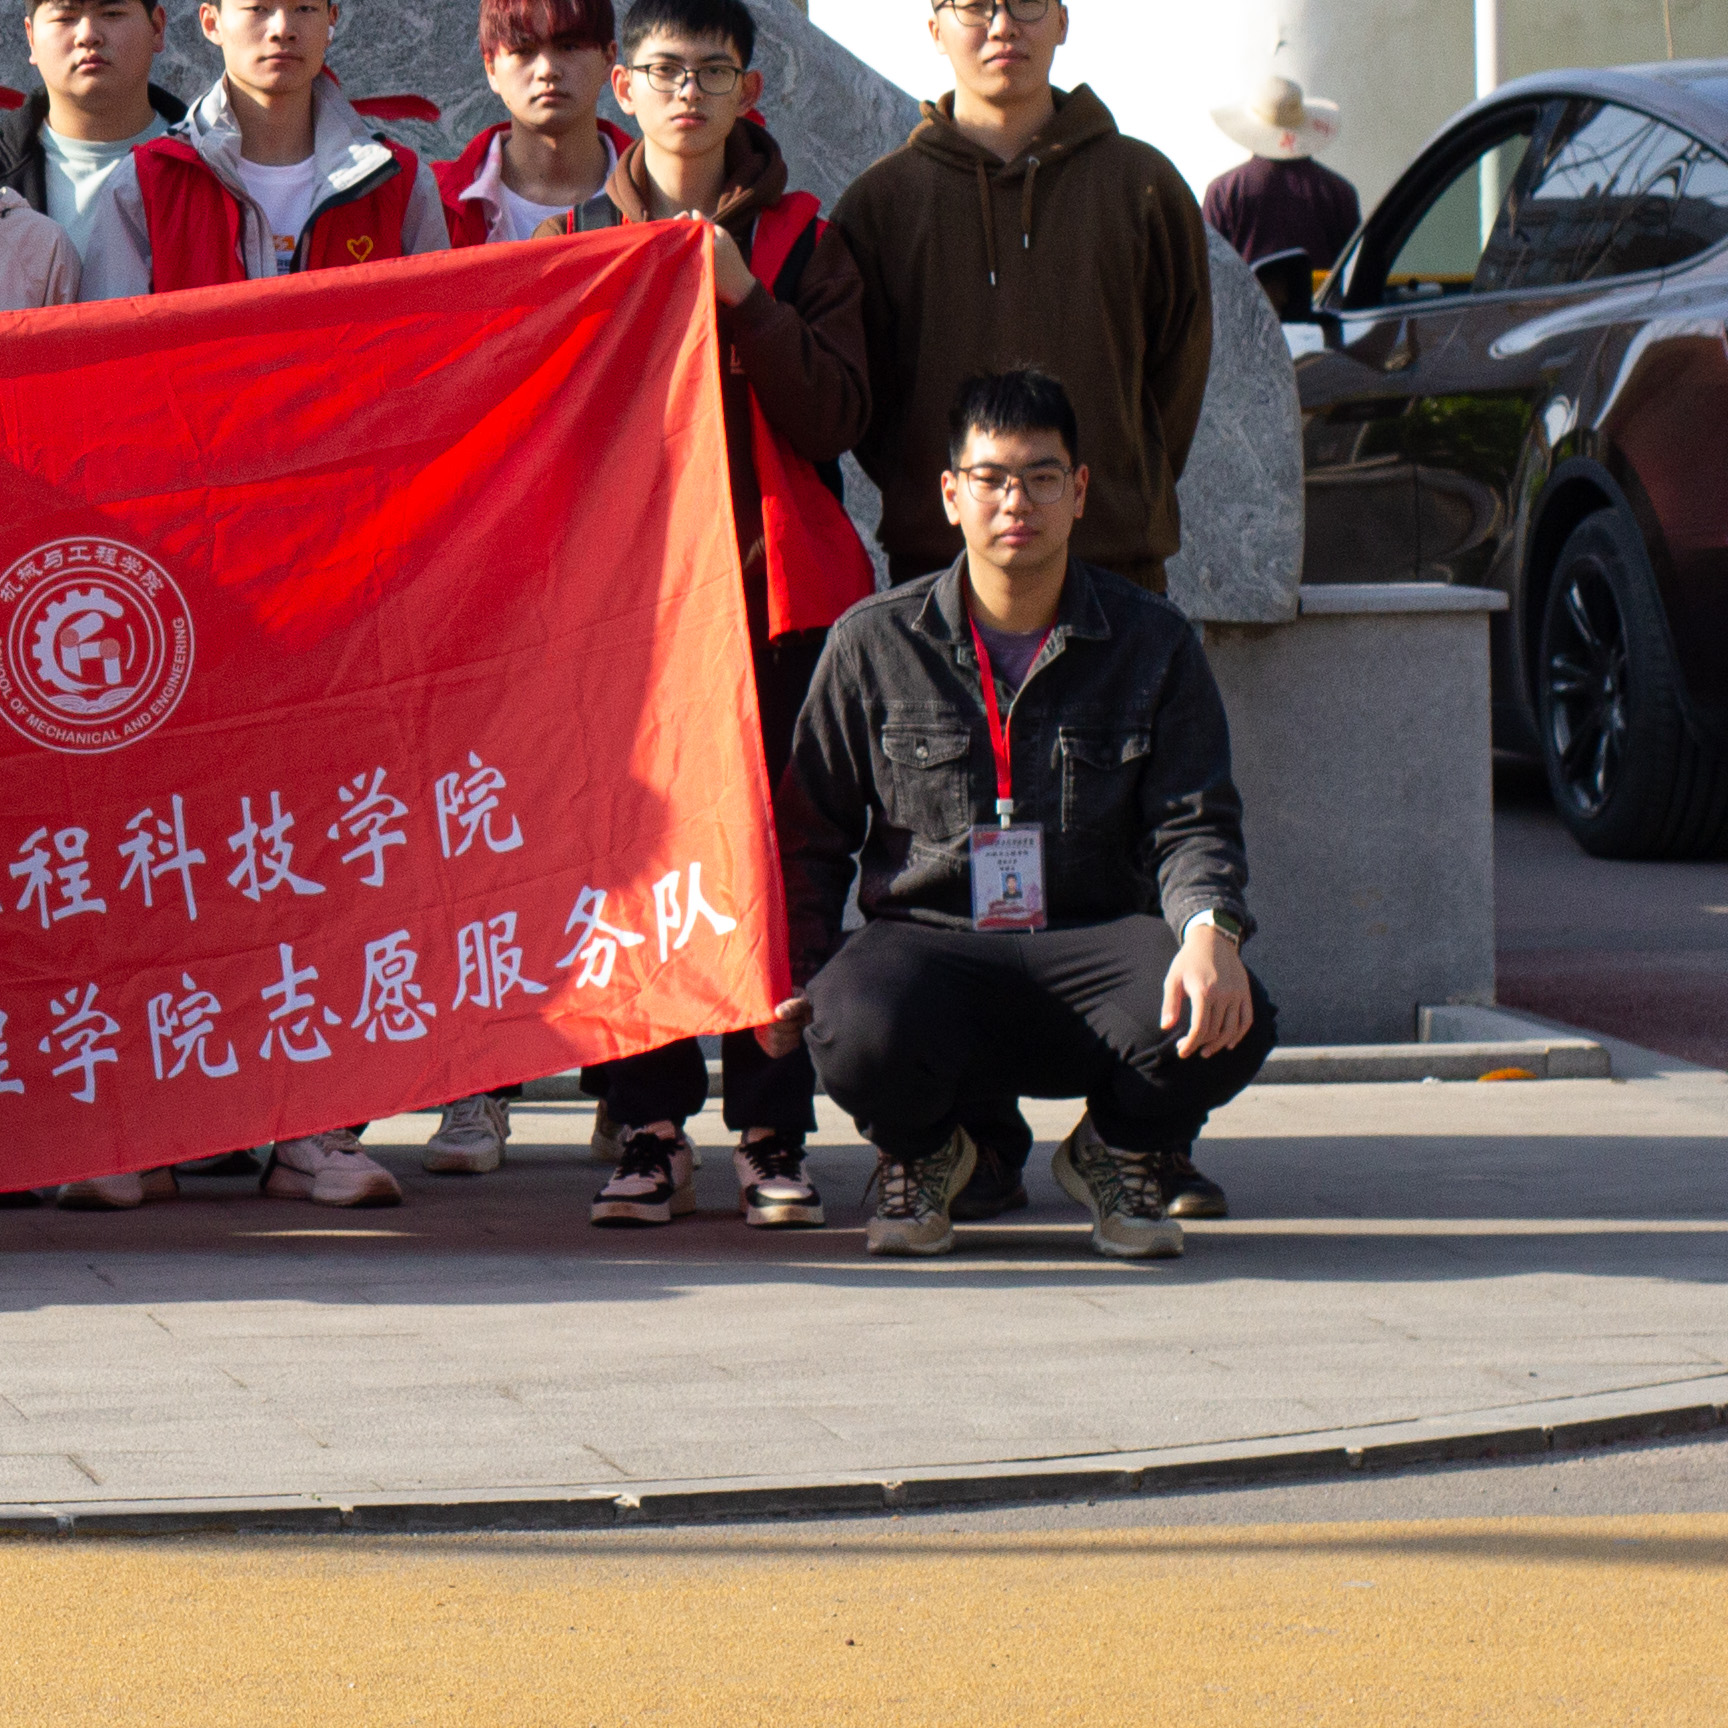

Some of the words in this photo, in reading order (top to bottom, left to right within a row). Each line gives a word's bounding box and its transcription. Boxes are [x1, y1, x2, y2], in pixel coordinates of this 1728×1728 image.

[10, 698, 30, 716] OF
[26, 713, 122, 745] MECHANICAL
[123, 711, 153, 737] AND
[149, 616, 186, 716] ENGINEERING
